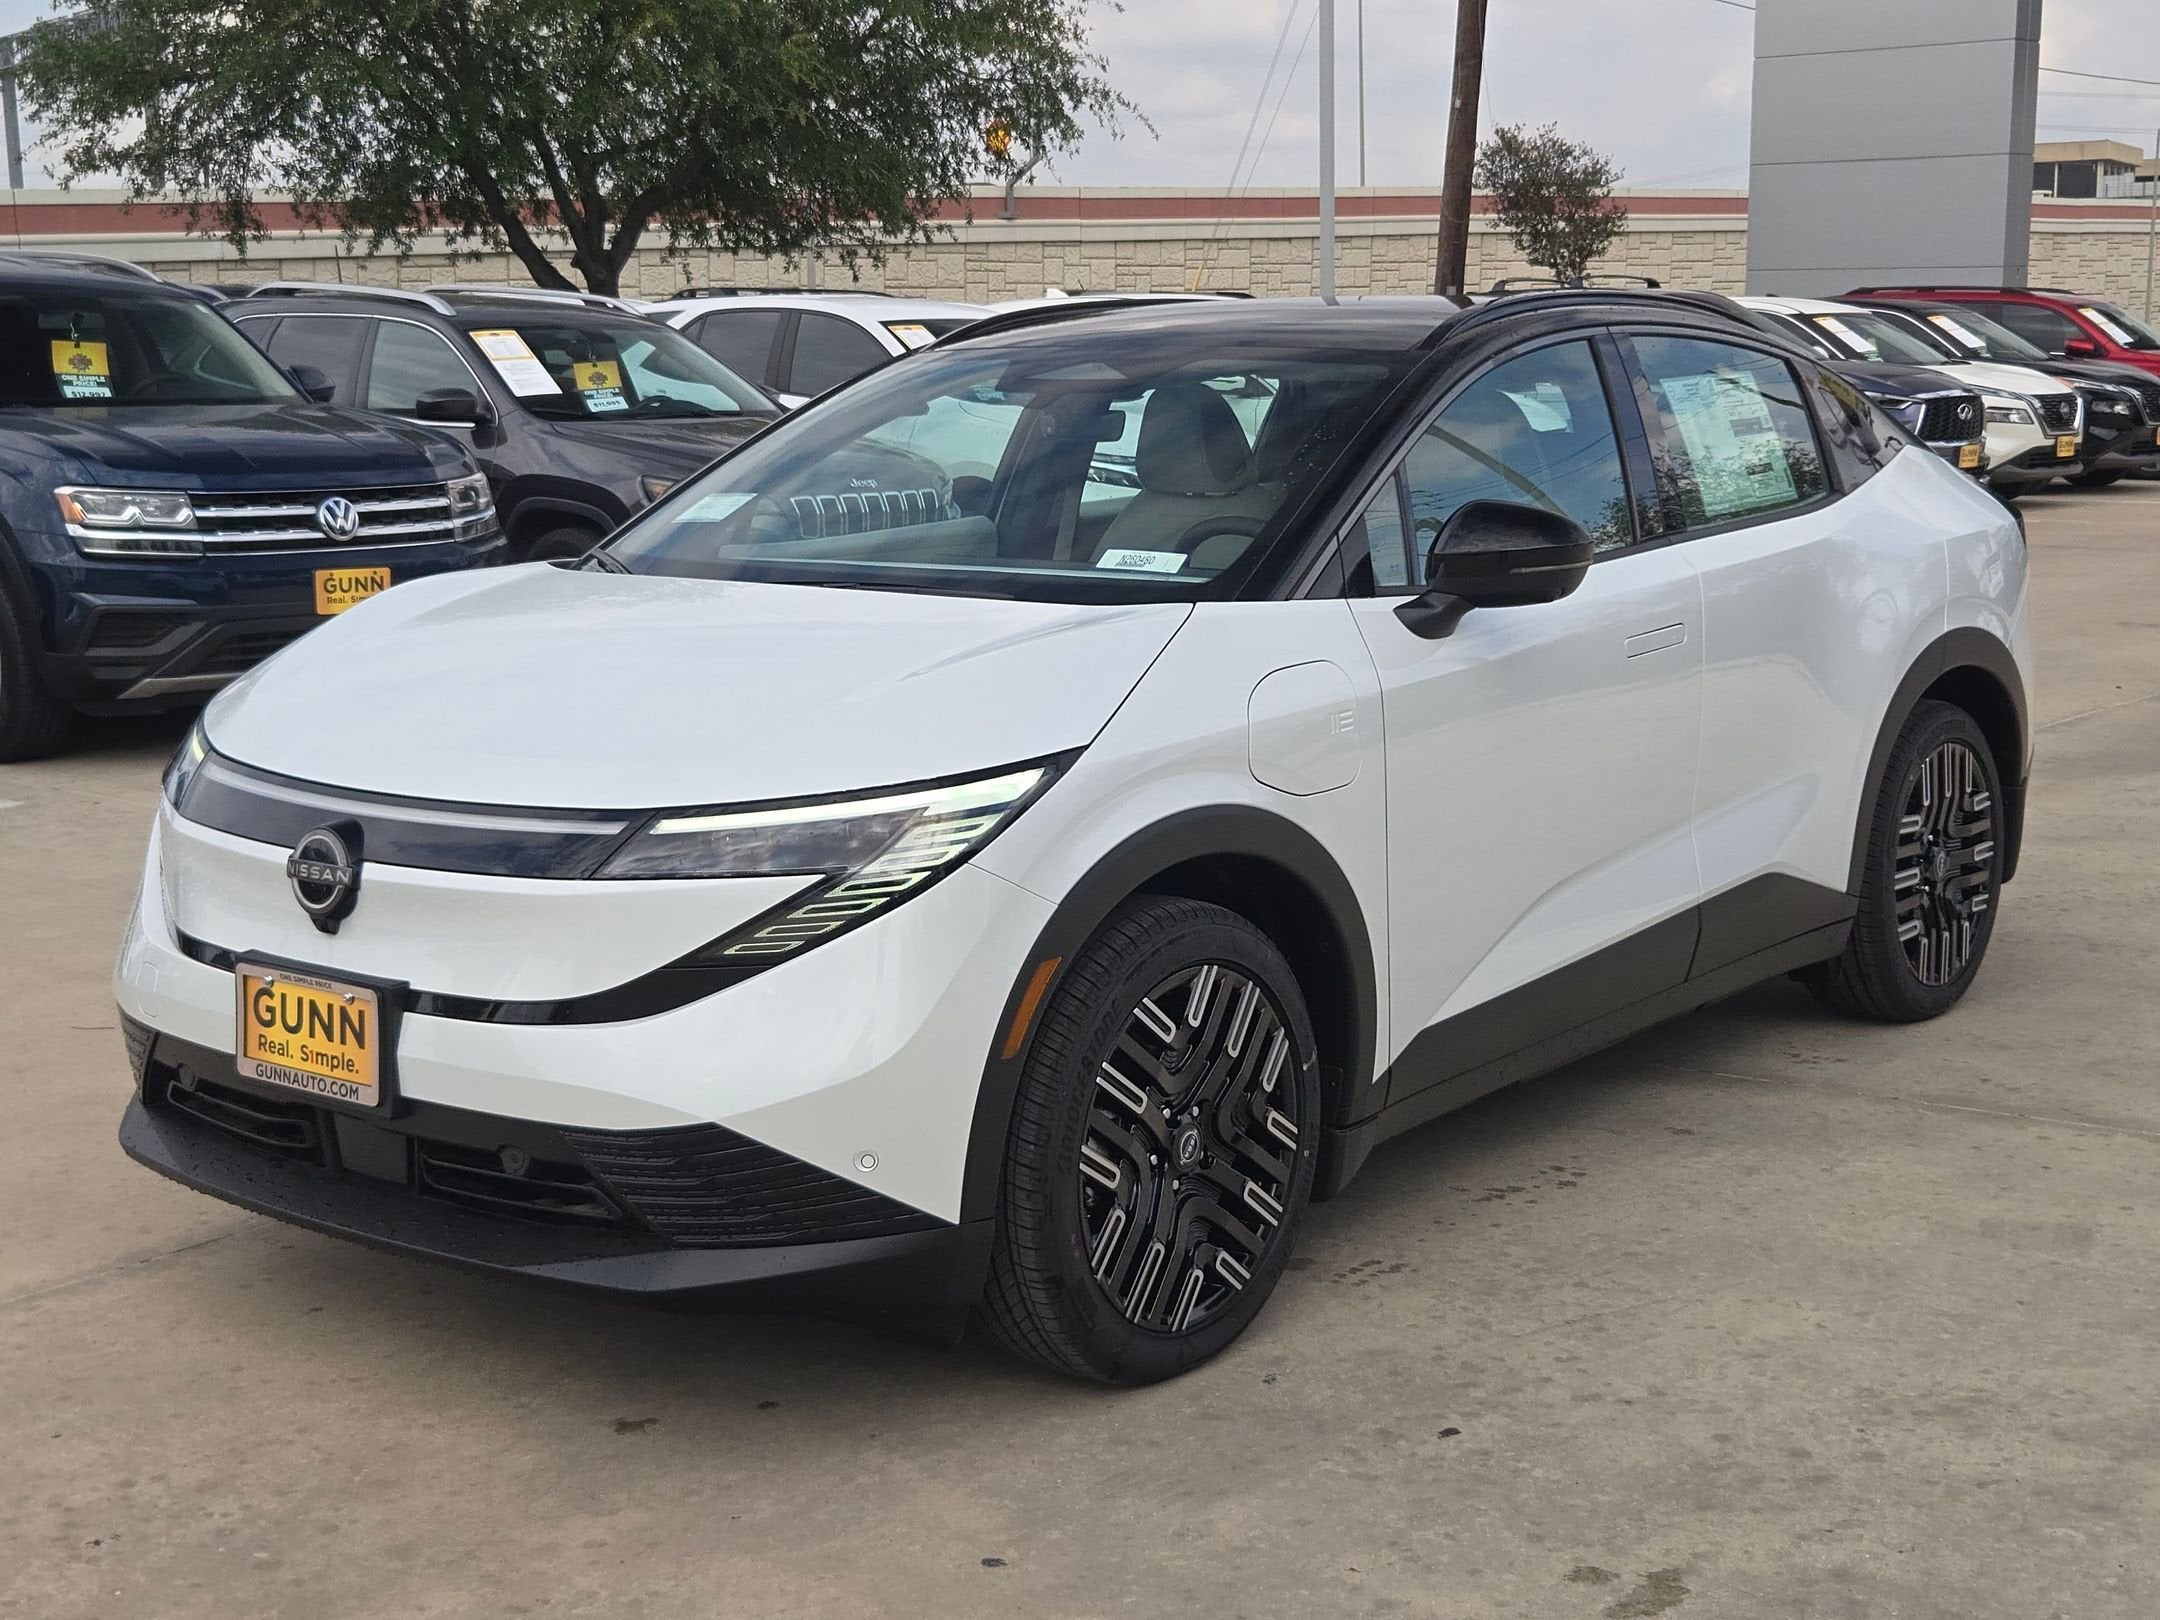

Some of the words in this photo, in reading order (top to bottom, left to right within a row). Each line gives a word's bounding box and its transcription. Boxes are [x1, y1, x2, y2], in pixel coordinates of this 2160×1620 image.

[850, 478, 878, 489] Jeep
[323, 575, 385, 595] GUNN
[288, 861, 351, 883] NISSAN
[253, 986, 367, 1050] GUNN
[257, 1034, 294, 1060] Real.
[255, 1063, 360, 1102] GUNNAUTO.COM
